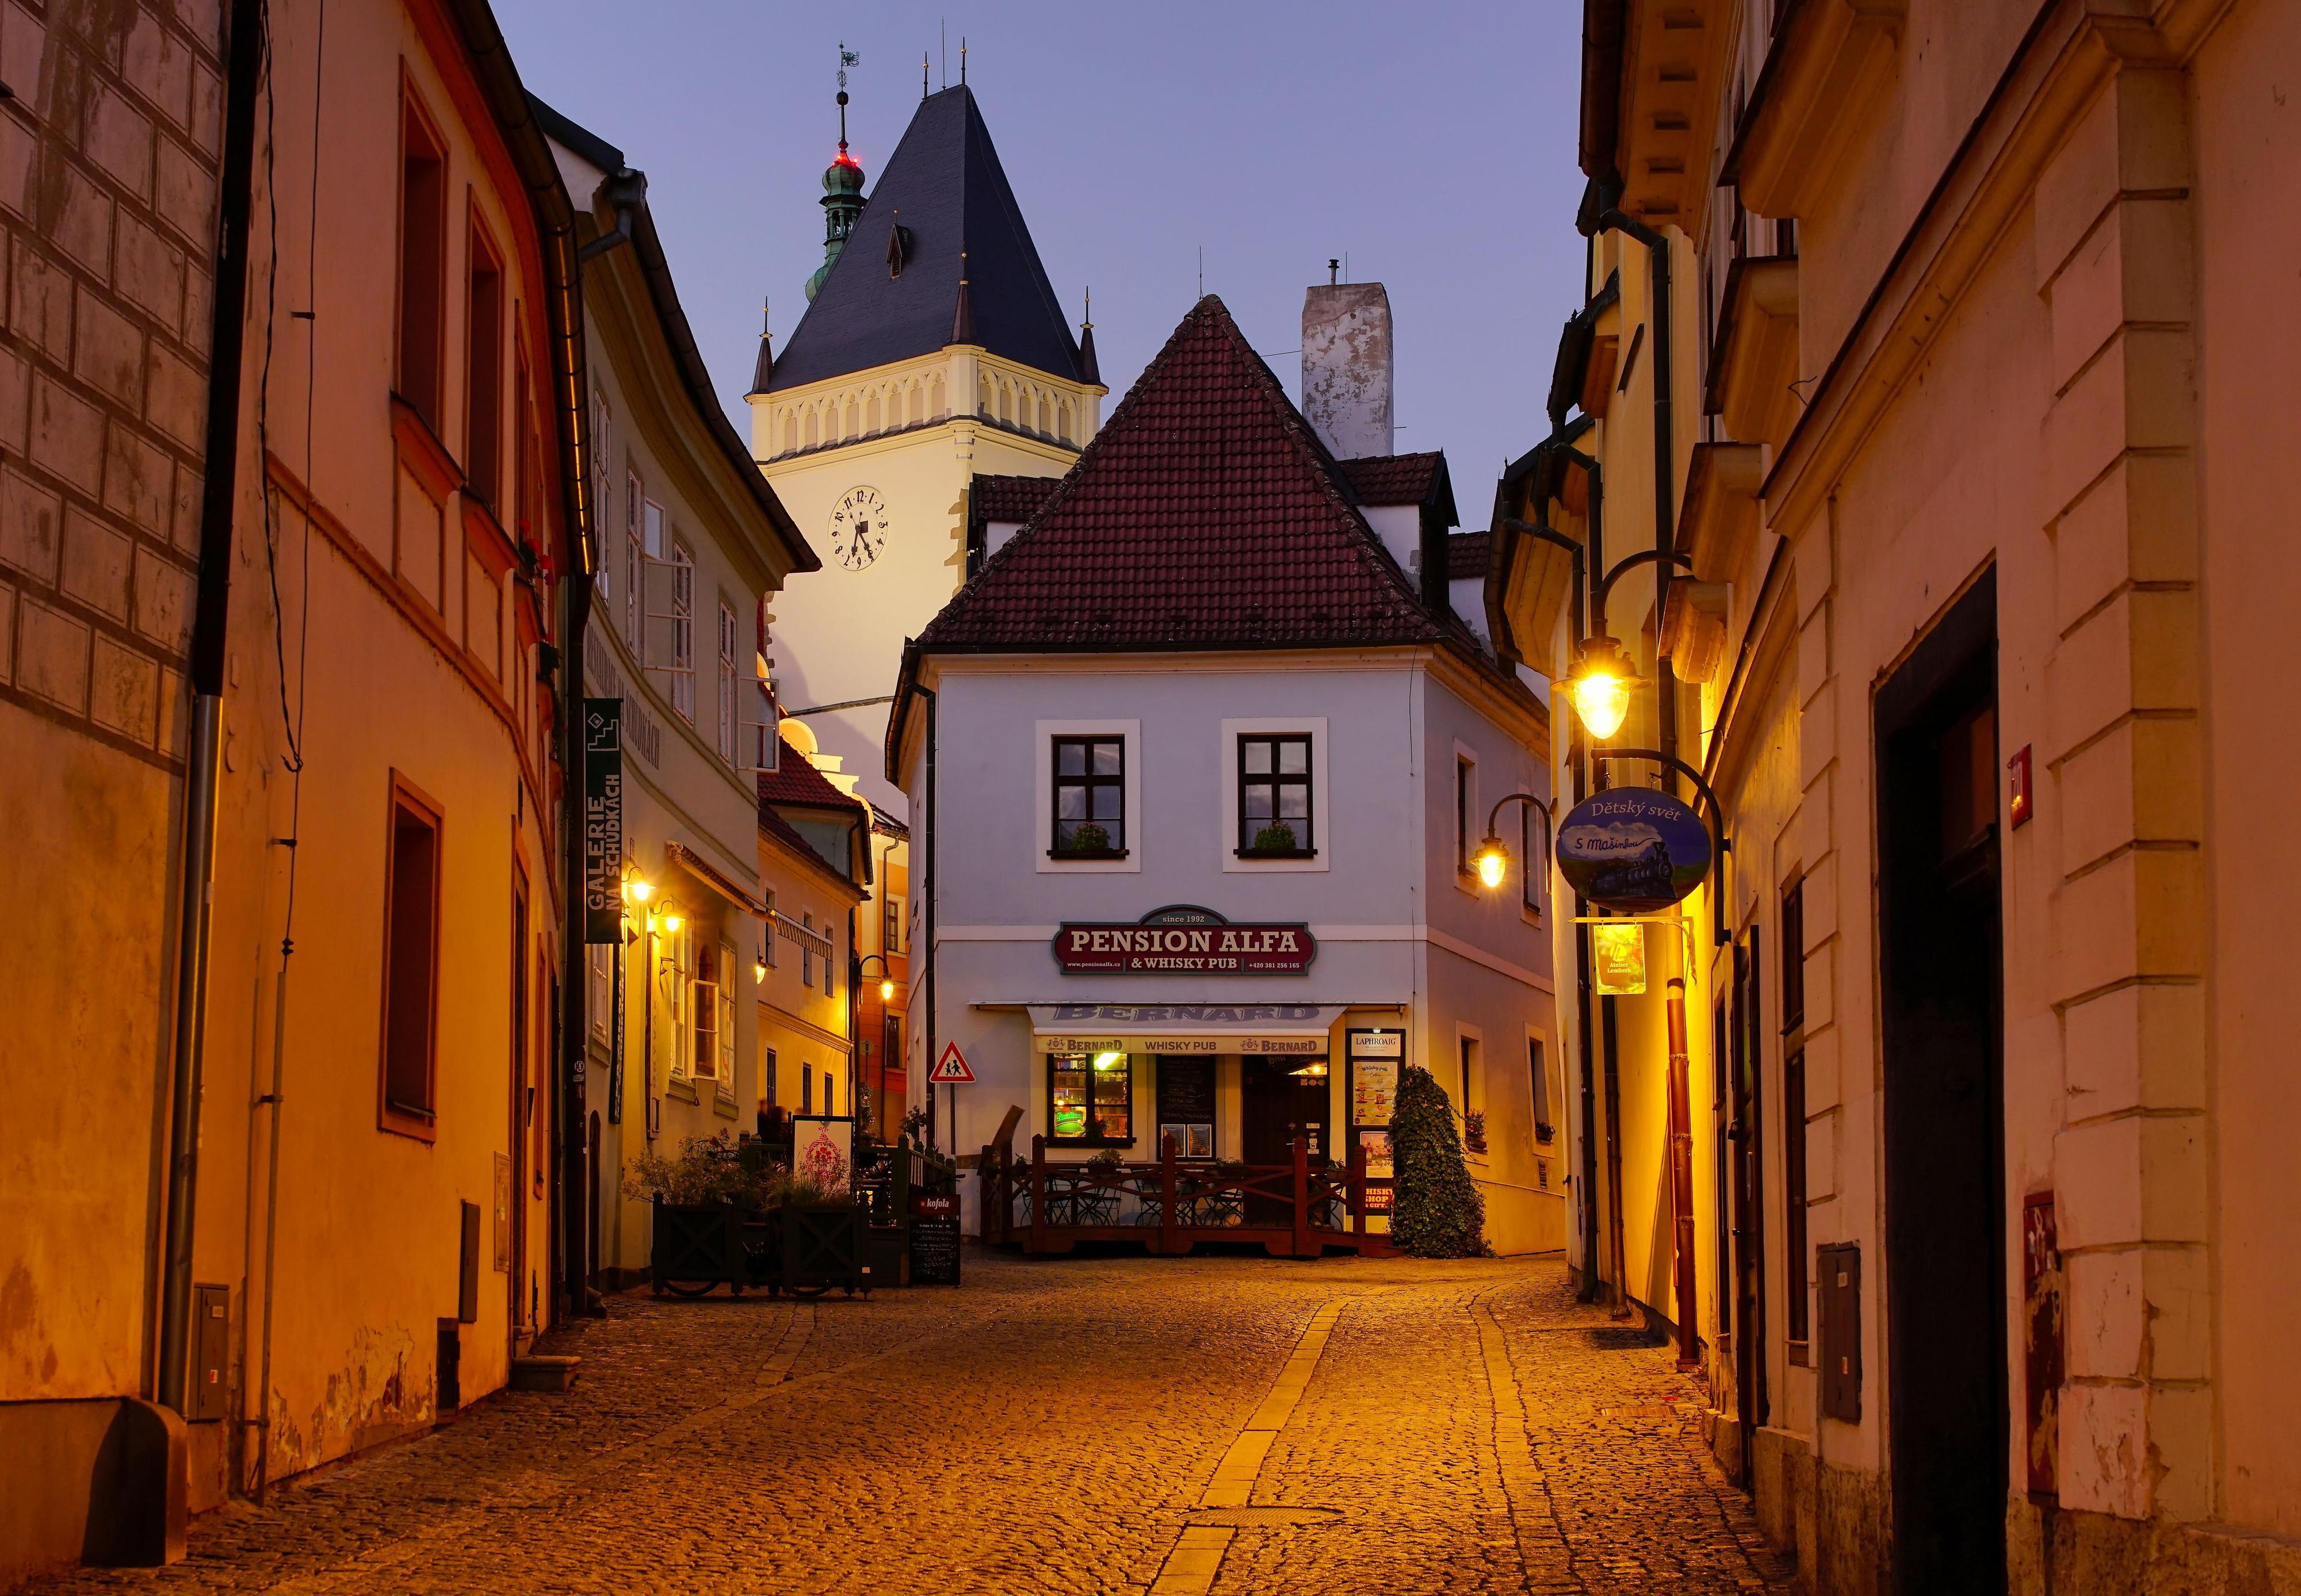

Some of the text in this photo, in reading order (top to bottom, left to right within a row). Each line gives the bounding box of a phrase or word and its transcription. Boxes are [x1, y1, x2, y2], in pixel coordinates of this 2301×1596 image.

[857, 489, 864, 503] 12
[869, 492, 874, 504] 1
[844, 497, 853, 510] 11
[876, 504, 884, 514] 2
[834, 512, 844, 522] 10
[878, 520, 888, 529] 3
[876, 538, 884, 546] 4
[835, 545, 843, 554] 8
[843, 554, 850, 567] 7
[857, 556, 861, 569] 6
[1591, 800, 1681, 821] Dětský svět
[604, 774, 620, 910] NA SCHŮDKÁCH
[587, 797, 604, 910] GALERIE
[1071, 931, 1299, 952] PENSION ALFA
[1131, 958, 1237, 969] & WHISKY PUB
[1050, 1005, 1320, 1022] BERNARD
[1067, 1039, 1122, 1051] BERNARD
[1145, 1042, 1217, 1051] WHISKY PUB
[1262, 1040, 1317, 1052] BERNARD
[927, 1198, 949, 1210] kofola
